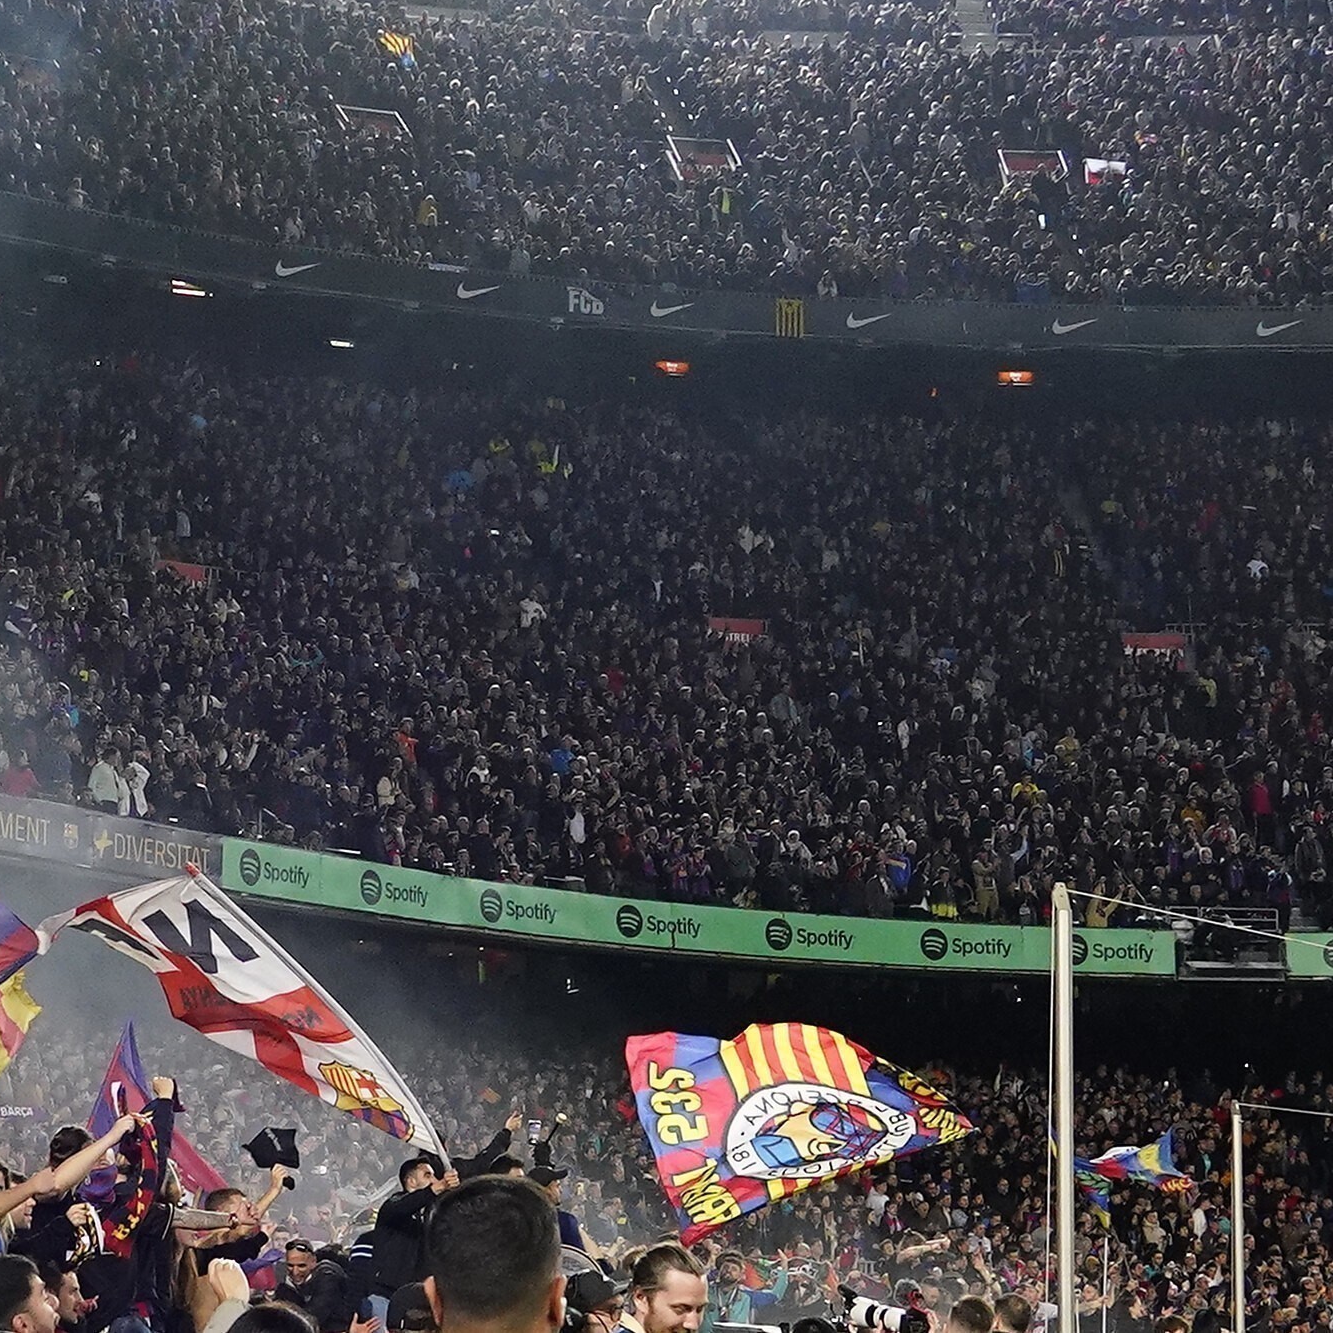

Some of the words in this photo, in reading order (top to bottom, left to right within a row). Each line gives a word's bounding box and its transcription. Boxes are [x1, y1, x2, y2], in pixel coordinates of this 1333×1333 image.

[114, 832, 211, 873] DIVERSITAT
[263, 861, 310, 889] Spotify
[385, 882, 429, 908] Spotify
[505, 899, 557, 924] Spotify
[646, 915, 702, 939] Spotify
[796, 928, 854, 950] Spotify
[951, 937, 1012, 958] Spotify
[1092, 943, 1154, 963] Spotify
[0, 1104, 34, 1118] BARÇA
